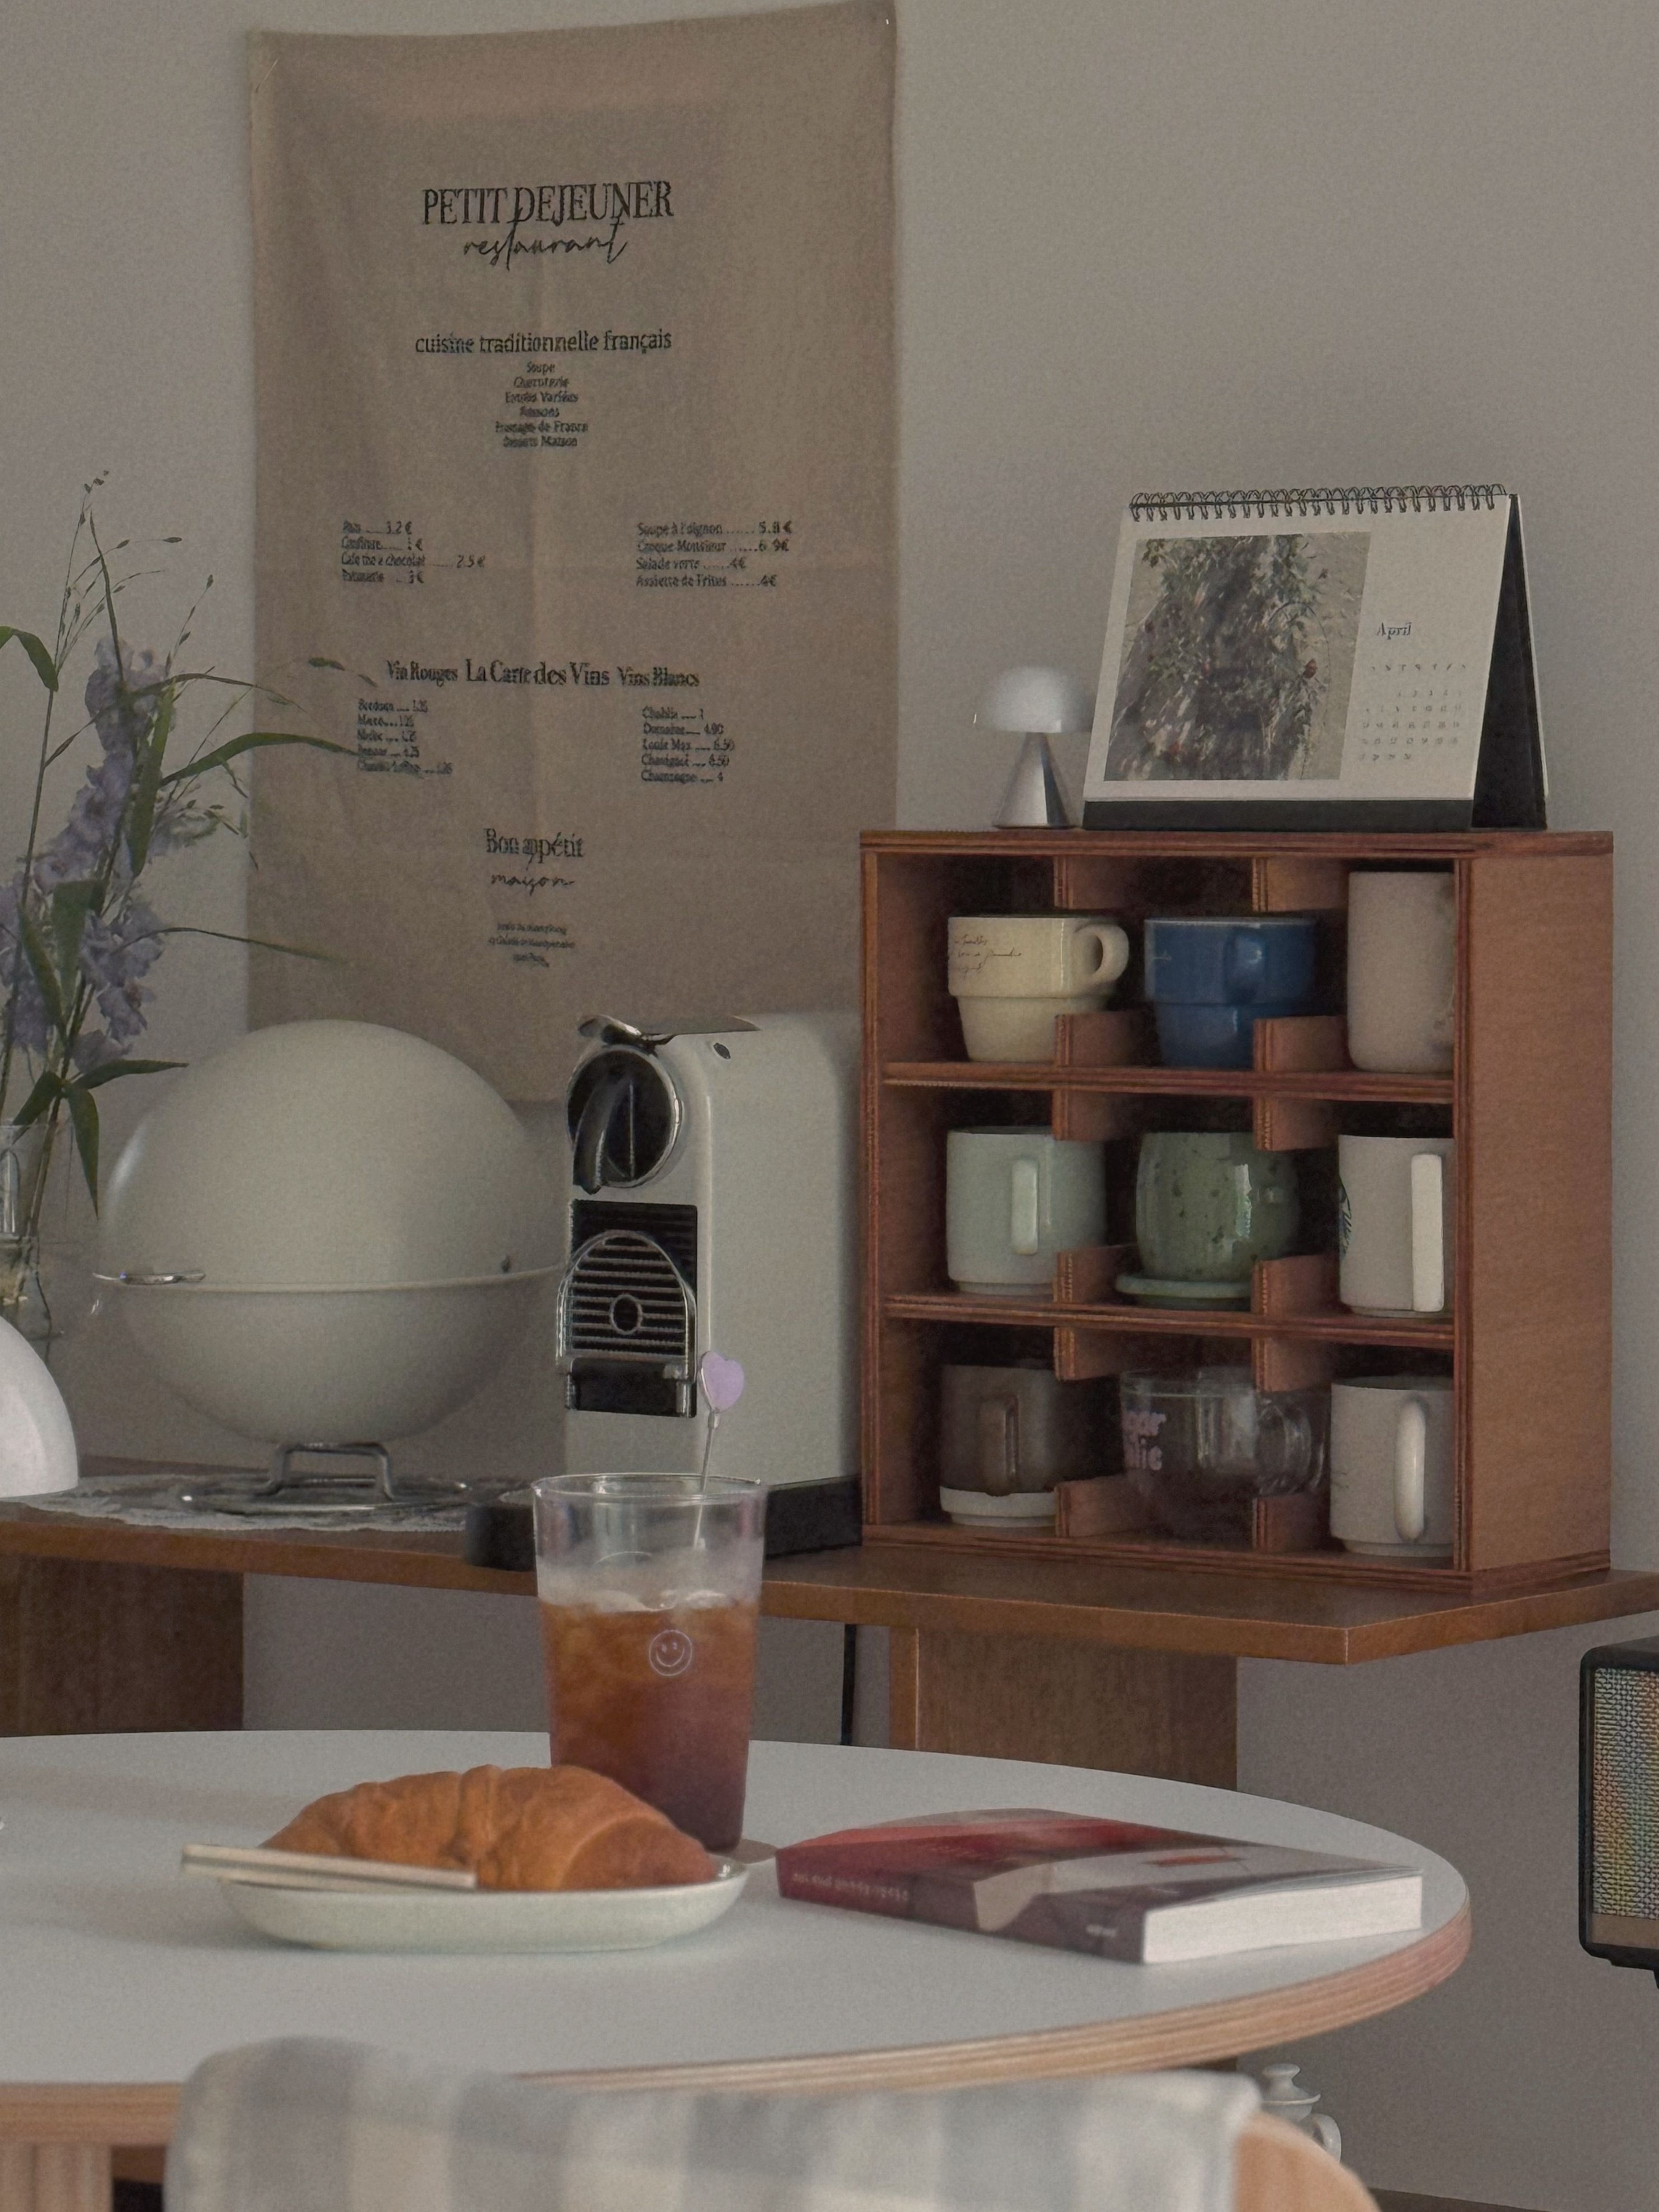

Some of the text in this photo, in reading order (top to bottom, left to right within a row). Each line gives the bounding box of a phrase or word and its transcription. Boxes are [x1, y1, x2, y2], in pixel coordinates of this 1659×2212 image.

[422, 180, 675, 227] PETIT DEJEUNER
[480, 330, 598, 354] traditionnelle
[603, 328, 672, 354] français
[1376, 621, 1413, 640] April
[465, 658, 488, 682] La
[533, 662, 567, 685] des
[570, 662, 610, 685] Vins
[483, 828, 520, 855] Bon
